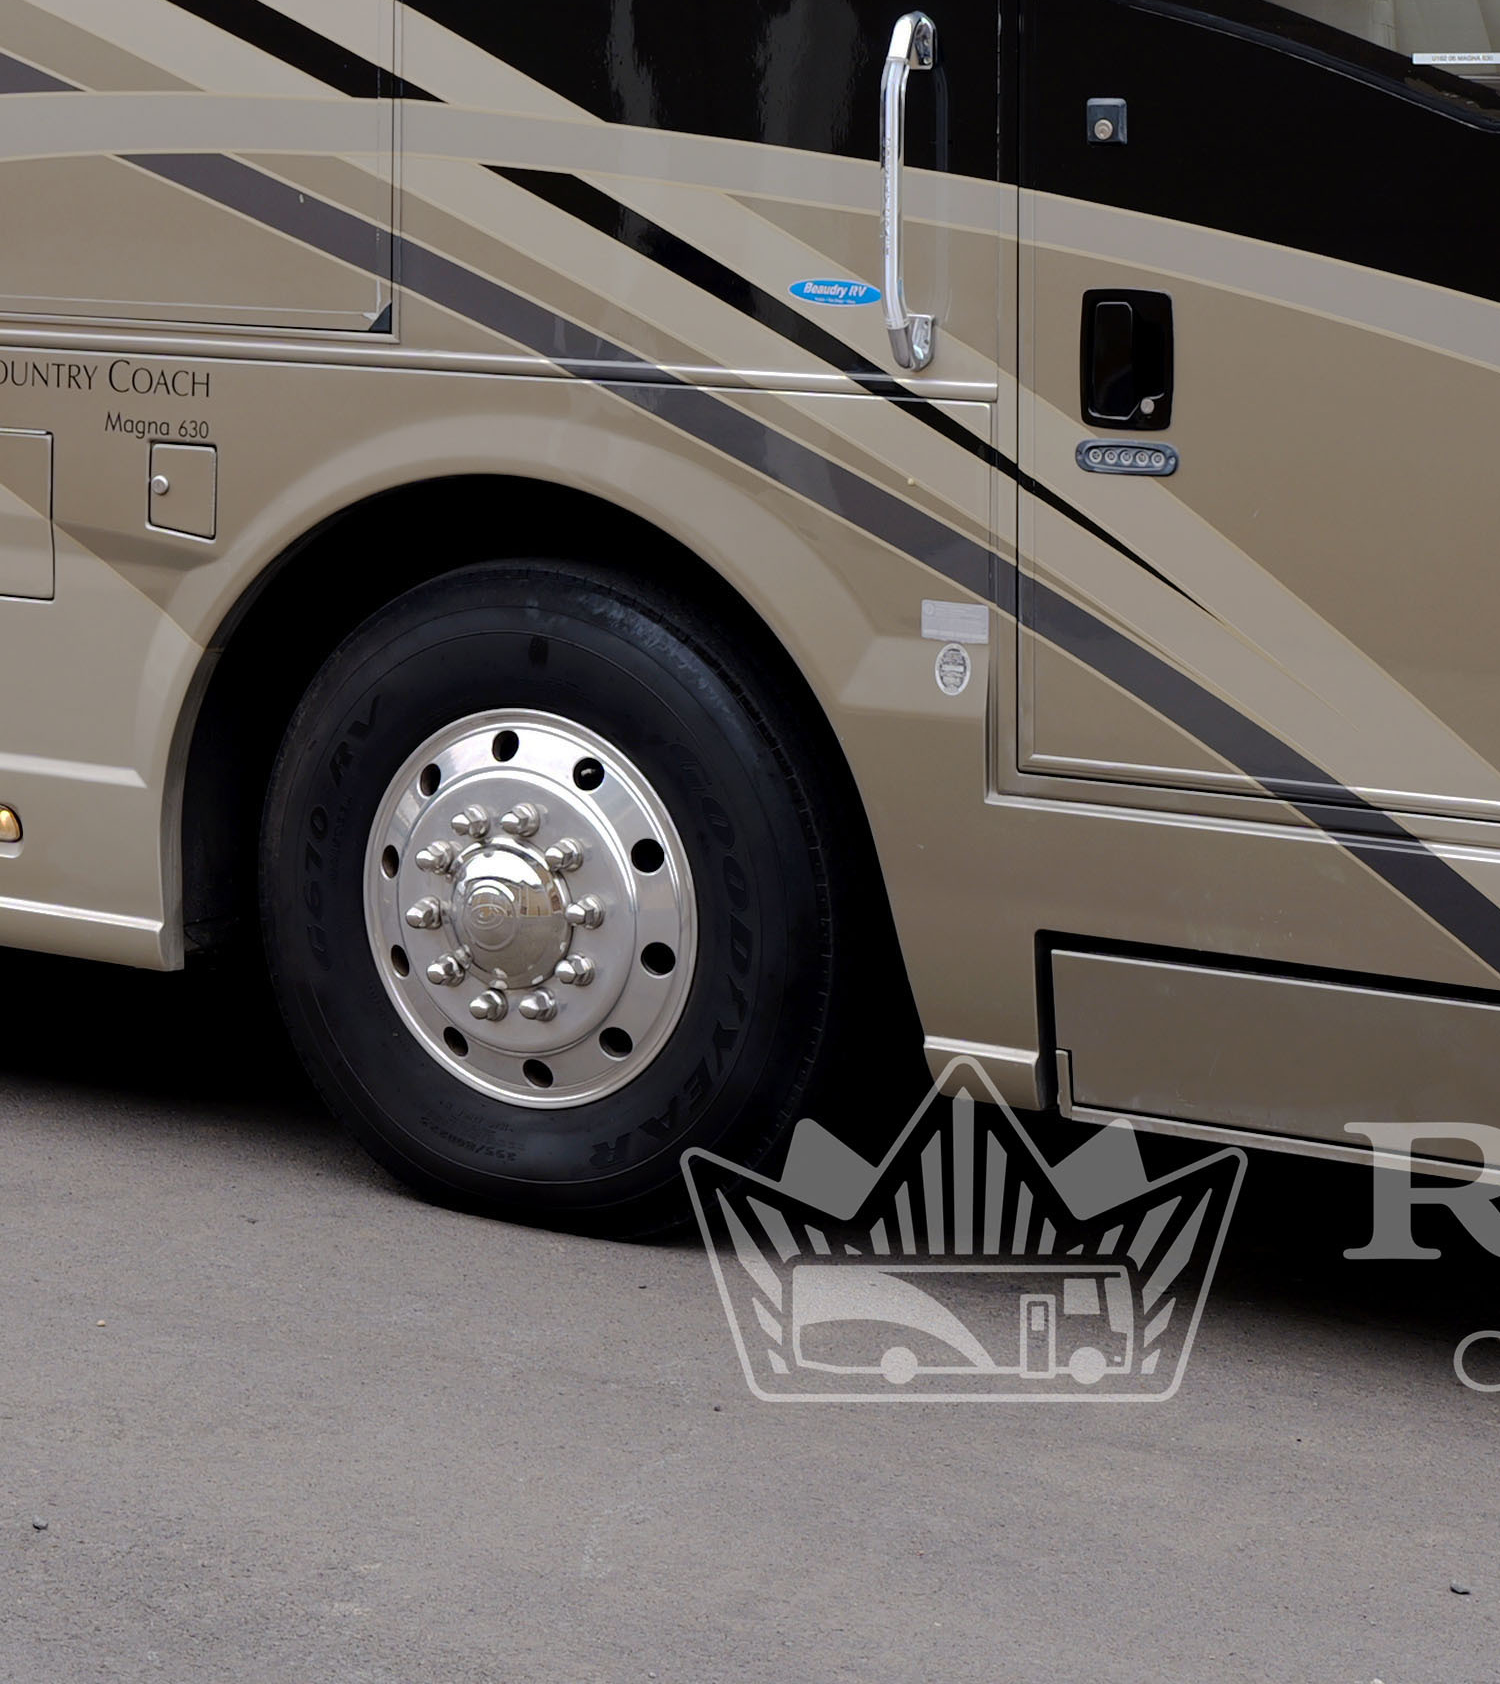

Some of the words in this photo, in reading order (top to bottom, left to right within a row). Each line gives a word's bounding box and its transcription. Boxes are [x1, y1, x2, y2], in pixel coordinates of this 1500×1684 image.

[803, 282, 848, 299] Beaudry
[849, 285, 867, 297] RV
[108, 359, 211, 398] COACH
[104, 411, 170, 439] Magna
[178, 419, 209, 439] 630
